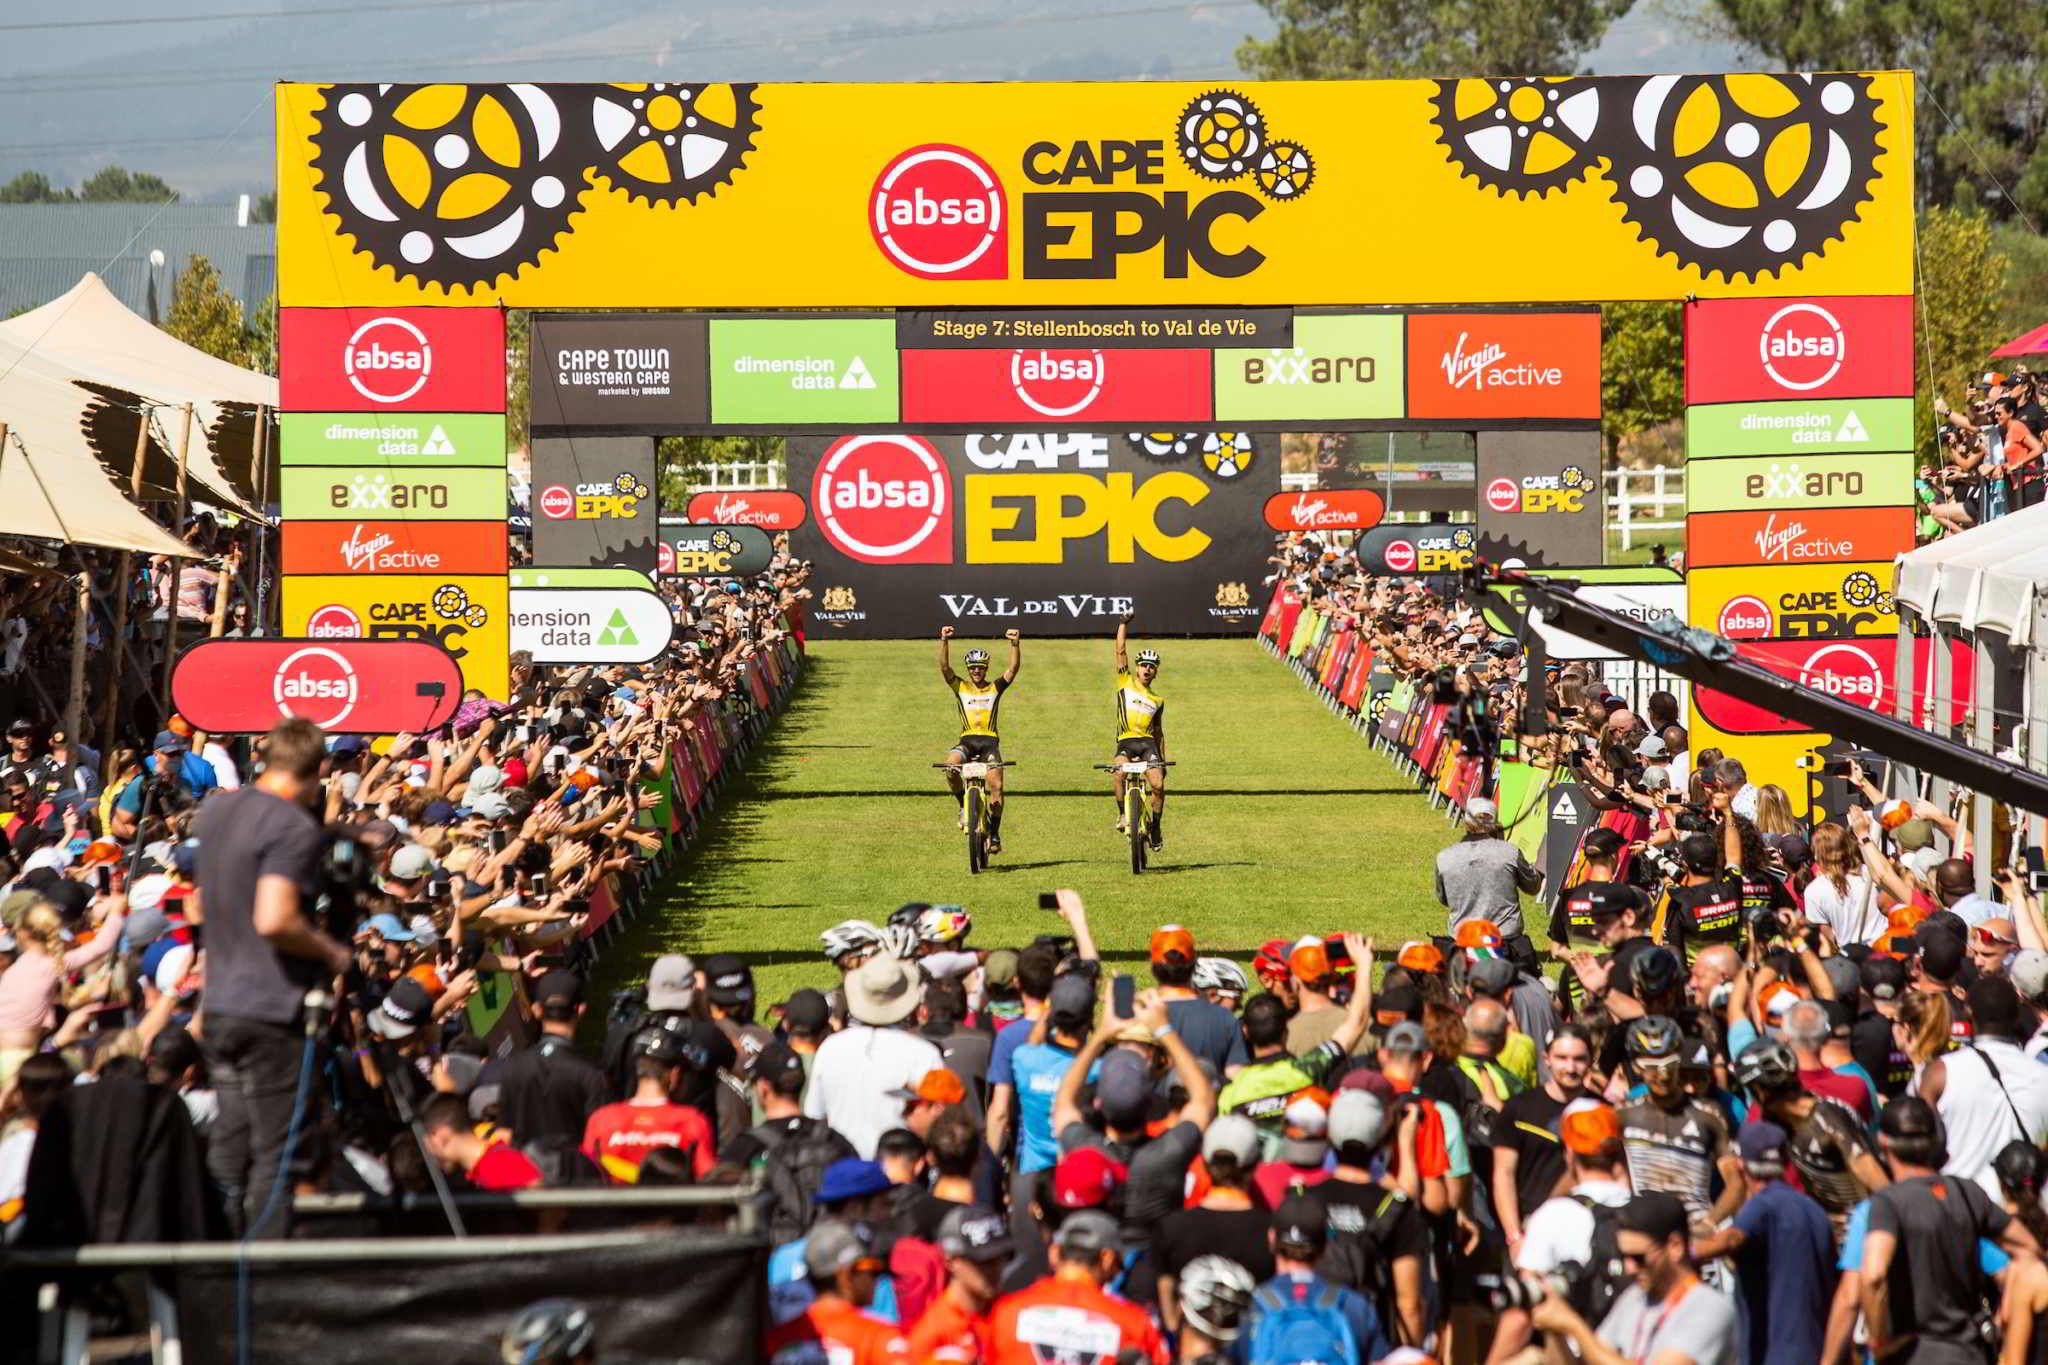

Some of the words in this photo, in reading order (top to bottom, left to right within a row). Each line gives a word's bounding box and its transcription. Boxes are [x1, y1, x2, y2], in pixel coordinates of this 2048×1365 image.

[1022, 140, 1164, 185] CAPE
[891, 187, 986, 225] absa
[1022, 191, 1266, 279] EPIC
[933, 320, 987, 339] Stage
[993, 321, 1010, 336] 7:
[1013, 320, 1136, 336] Stellenbosch
[1140, 322, 1160, 336] to
[1163, 320, 1193, 336] Val
[1199, 320, 1222, 336] de
[1225, 320, 1257, 335] Vie
[1771, 329, 1835, 357] absa
[355, 342, 421, 369] absa
[558, 349, 609, 370] CAPE
[613, 348, 670, 370] TOWN
[734, 356, 835, 373] dimension
[1023, 351, 1093, 380] absa
[1440, 332, 1506, 390] Virgin
[1244, 348, 1376, 385] exxaro
[1487, 362, 1562, 386] active
[559, 372, 569, 385] &
[572, 371, 632, 385] WESTERN
[636, 371, 670, 385] CAPE
[791, 374, 835, 390] data
[631, 387, 640, 397] by
[1740, 411, 1832, 430] dimension
[325, 423, 417, 440] dimension
[1792, 428, 1832, 443] data
[378, 441, 418, 456] data
[964, 433, 1109, 469] CAPE
[576, 483, 612, 496] CAPE
[834, 468, 930, 509] absa
[1522, 475, 1559, 489] CAPE
[1746, 464, 1863, 498] exxaro
[331, 474, 448, 509] exxaro
[1522, 489, 1585, 512] EPIC
[576, 495, 637, 519] EPIC
[1316, 510, 1358, 524] active
[739, 511, 780, 524] active
[965, 471, 1213, 565] EPIC
[676, 540, 710, 552] CAPE
[1417, 538, 1451, 550] CAPE
[1754, 514, 1807, 560] Virgin
[1792, 537, 1853, 557] active
[340, 524, 395, 571] Virgin
[379, 550, 440, 568] active
[676, 551, 732, 573] EPIC
[1418, 550, 1473, 571] EPIC
[939, 594, 1019, 618] VAL
[1023, 601, 1058, 614] DE
[1058, 594, 1135, 618] VIE
[1779, 591, 1837, 611] CAPE
[369, 603, 427, 621] CAPE
[814, 612, 836, 620] VAL
[1208, 608, 1229, 616] VAL
[1726, 613, 1765, 630] absa
[314, 621, 355, 638] absa
[541, 628, 591, 646] data
[283, 671, 349, 698] absa
[1810, 668, 1873, 695] absa
